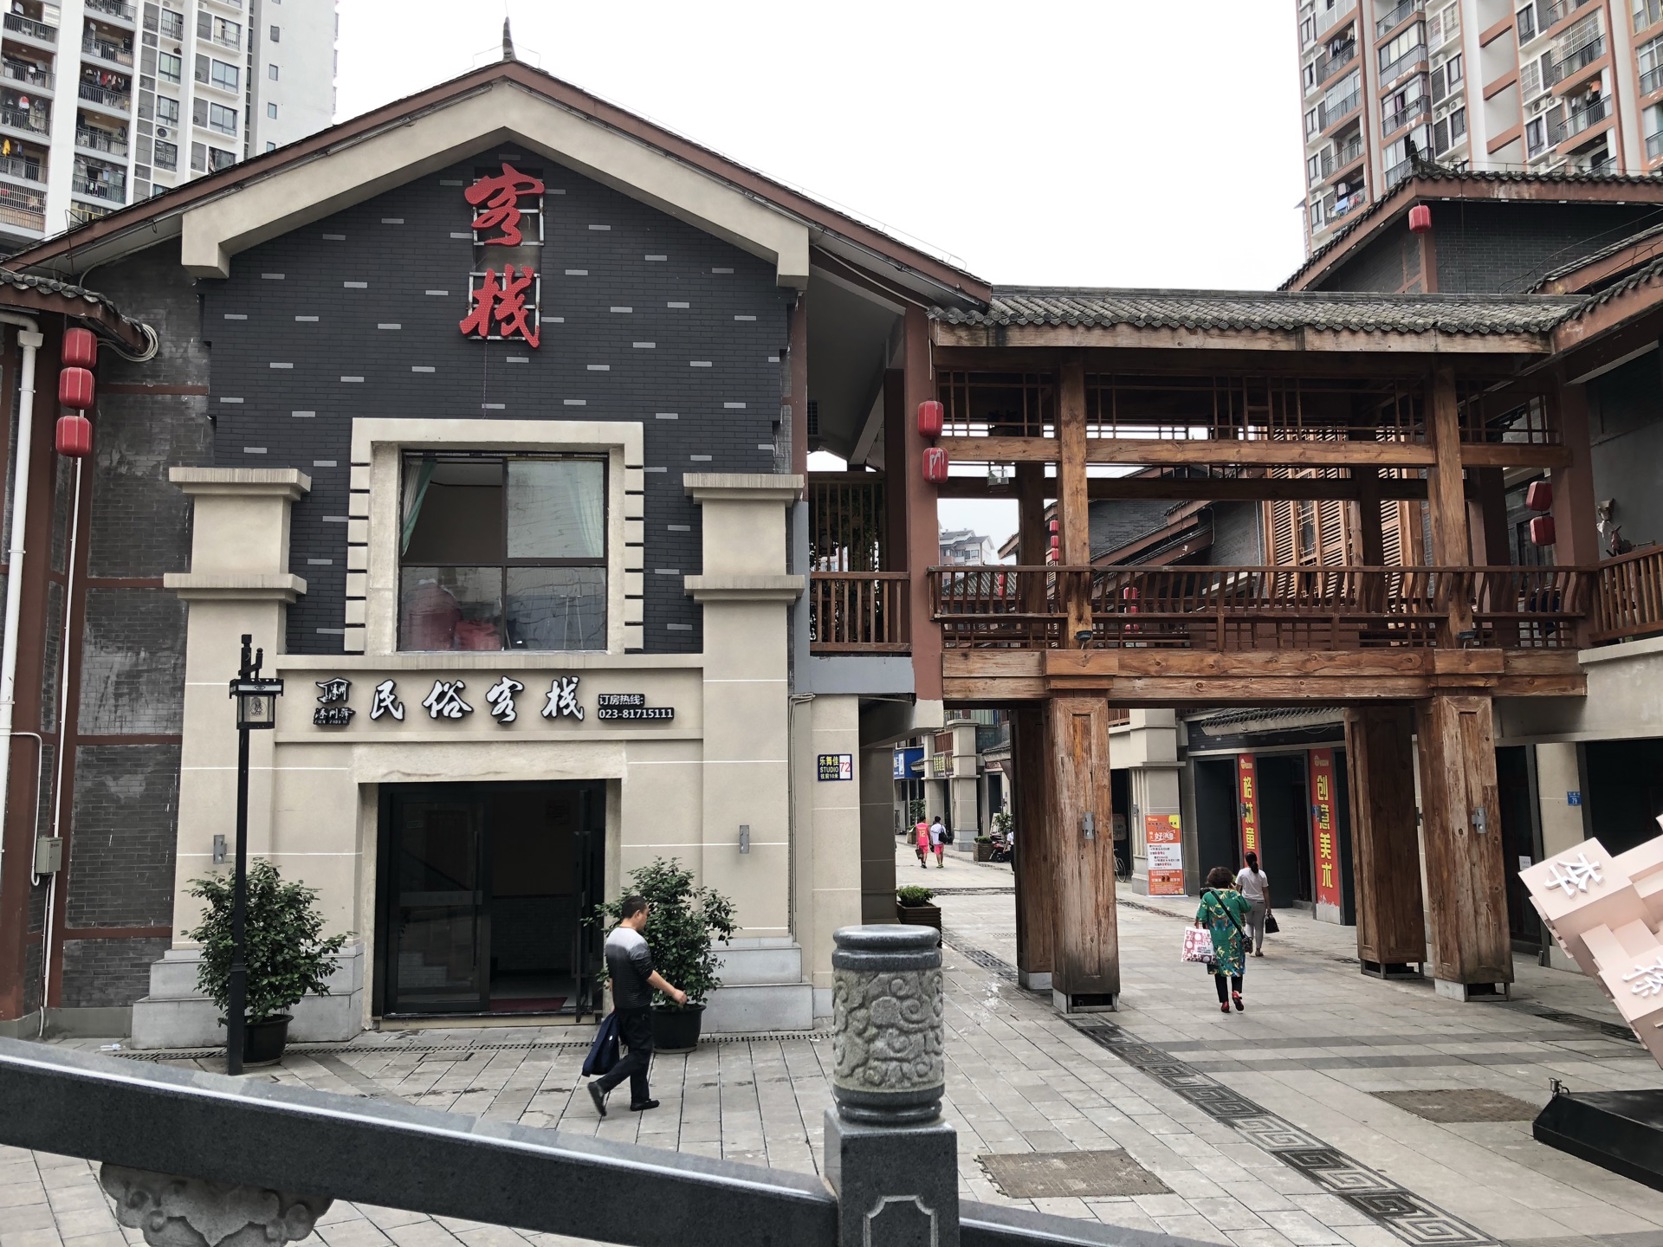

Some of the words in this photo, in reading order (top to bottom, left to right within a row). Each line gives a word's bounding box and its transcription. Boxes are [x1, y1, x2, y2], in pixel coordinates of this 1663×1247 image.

[459, 163, 545, 348] 客栈
[370, 677, 585, 723] 民俗客栈
[599, 709, 673, 719] 023-81715111
[1316, 774, 1334, 888] 创意美术
[1544, 852, 1603, 898] 李
